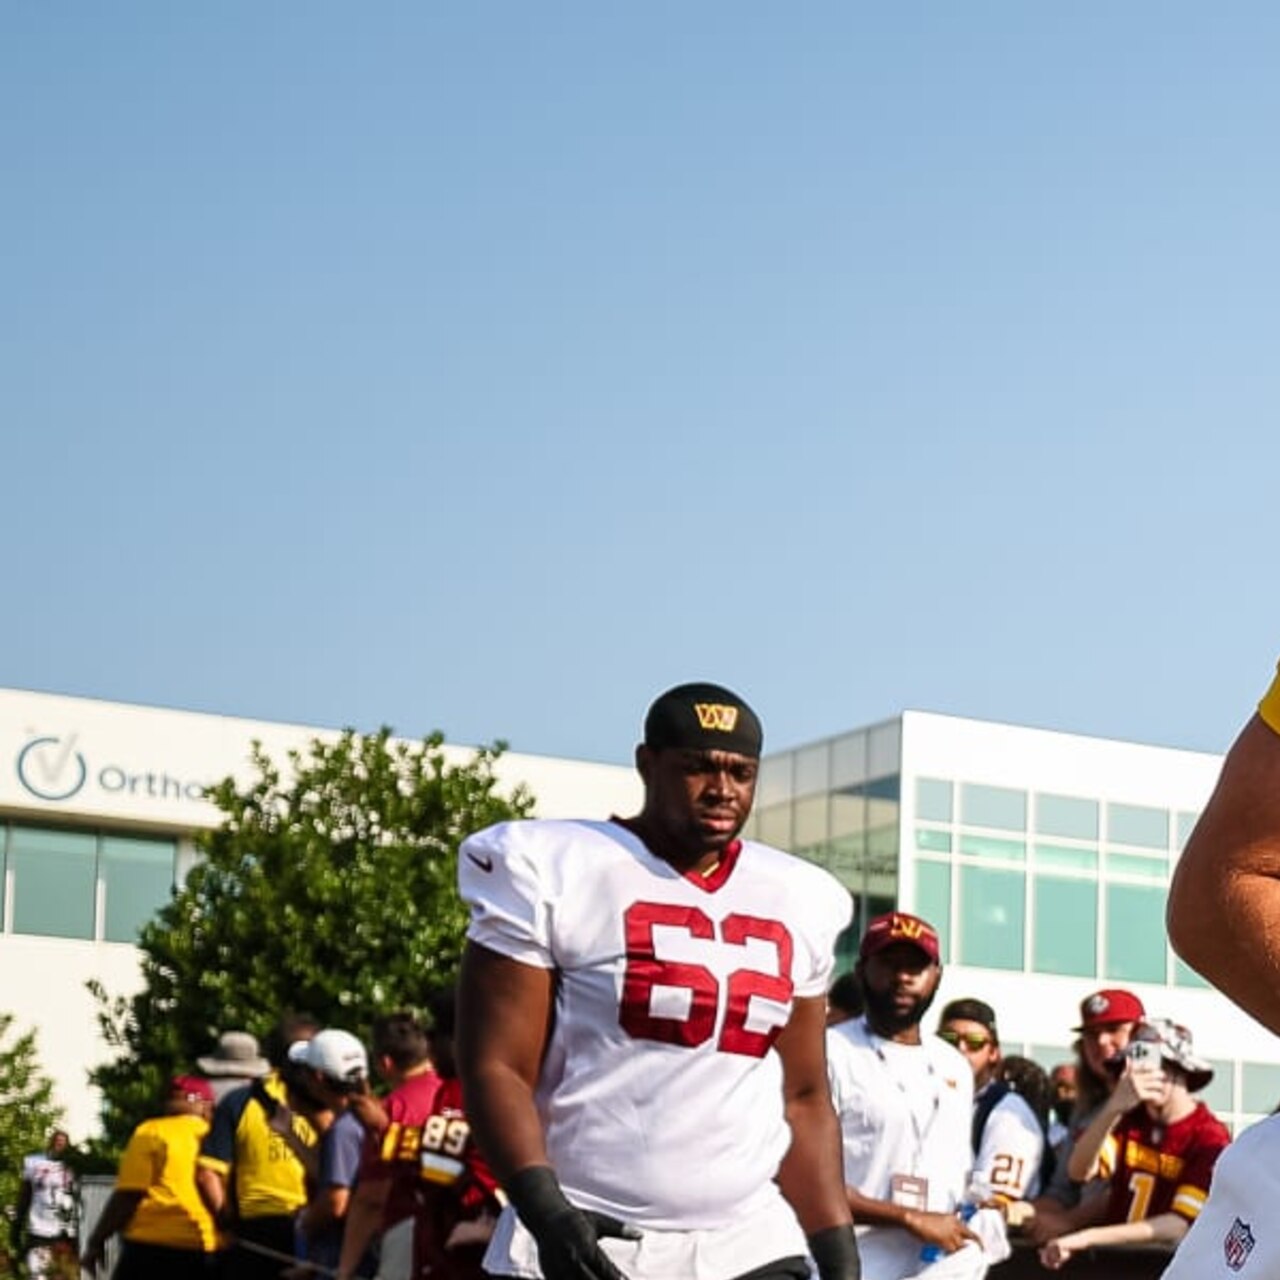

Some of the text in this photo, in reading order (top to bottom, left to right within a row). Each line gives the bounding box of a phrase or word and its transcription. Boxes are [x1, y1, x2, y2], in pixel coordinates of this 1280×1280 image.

[618, 900, 795, 1059] 62
[422, 1114, 471, 1156] 89
[990, 1154, 1025, 1190] 21
